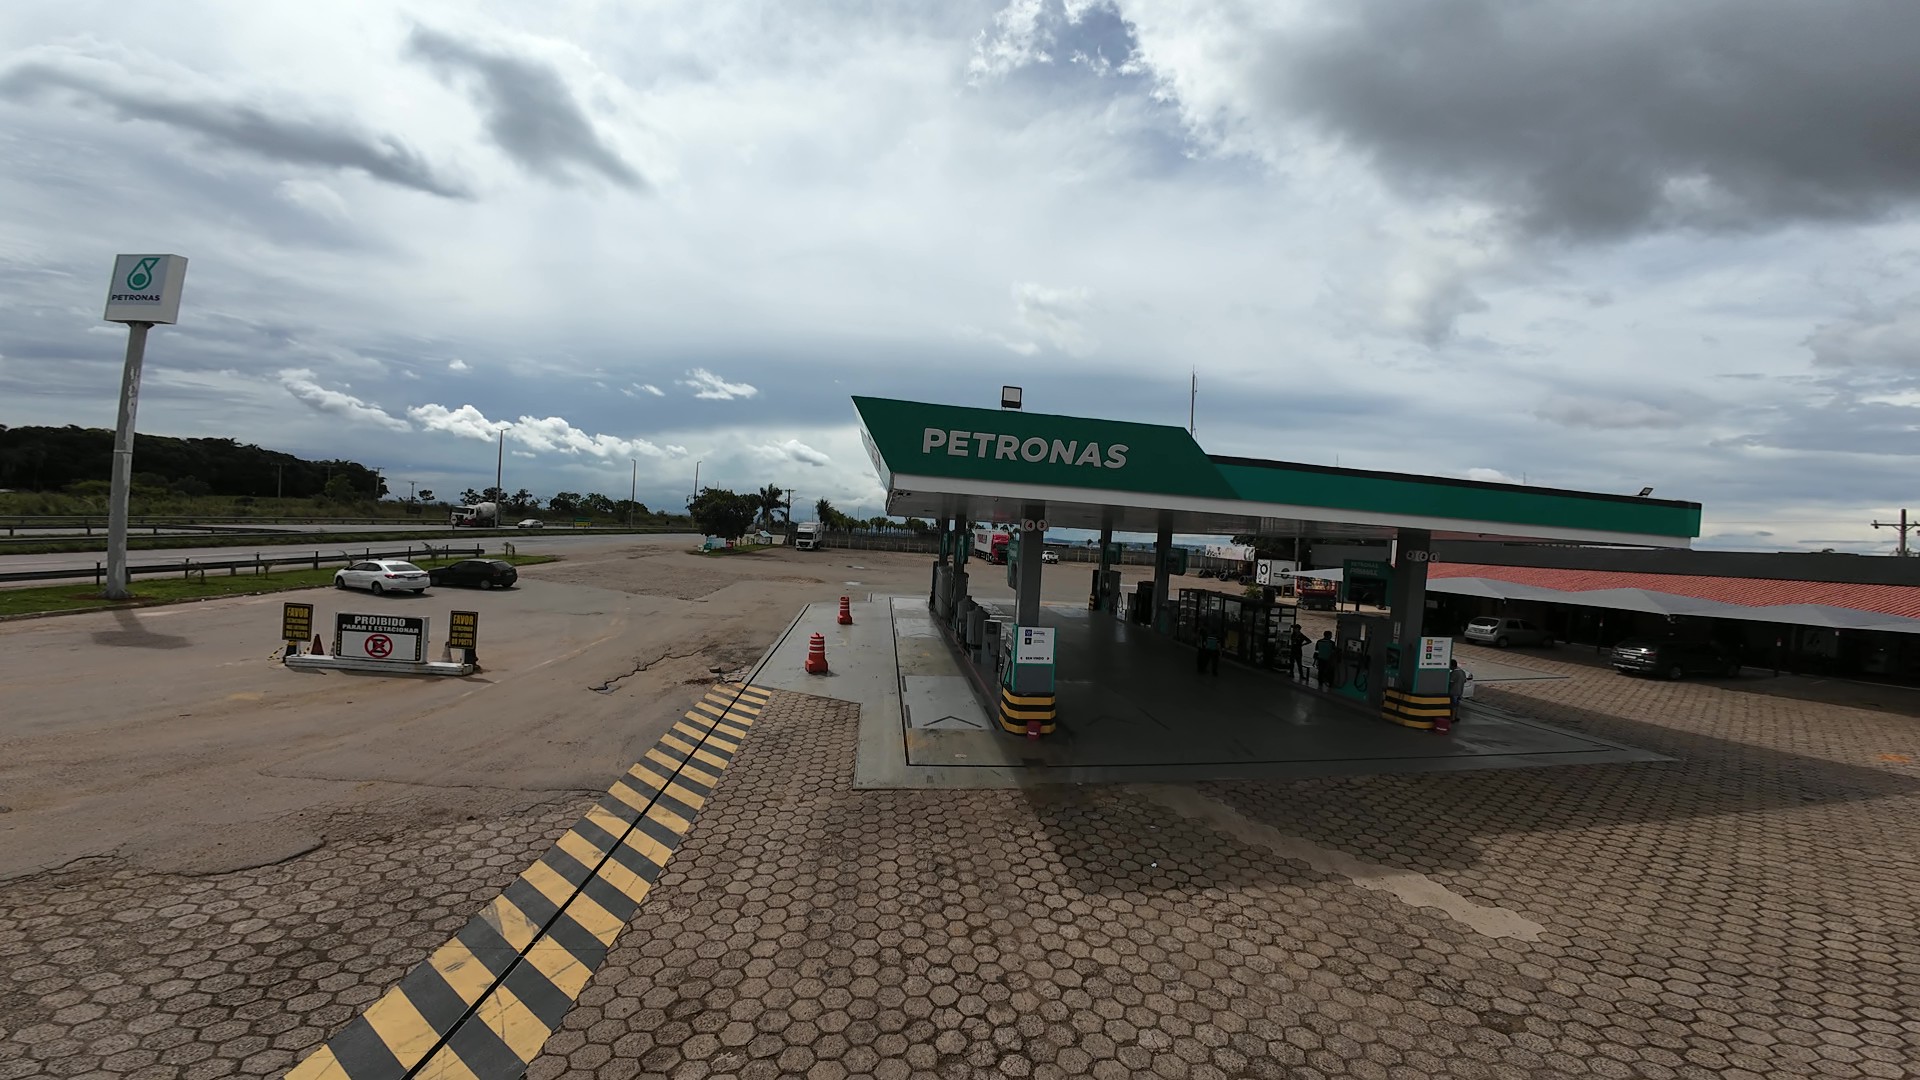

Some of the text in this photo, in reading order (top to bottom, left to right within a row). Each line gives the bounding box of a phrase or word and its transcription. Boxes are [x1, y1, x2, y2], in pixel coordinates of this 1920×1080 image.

[922, 427, 1129, 469] PETRONAS
[286, 607, 309, 618] FAVOR
[354, 615, 406, 627] PROIBIDO
[453, 614, 474, 625] FAVOR
[374, 626, 419, 634] ESTACIONAR
